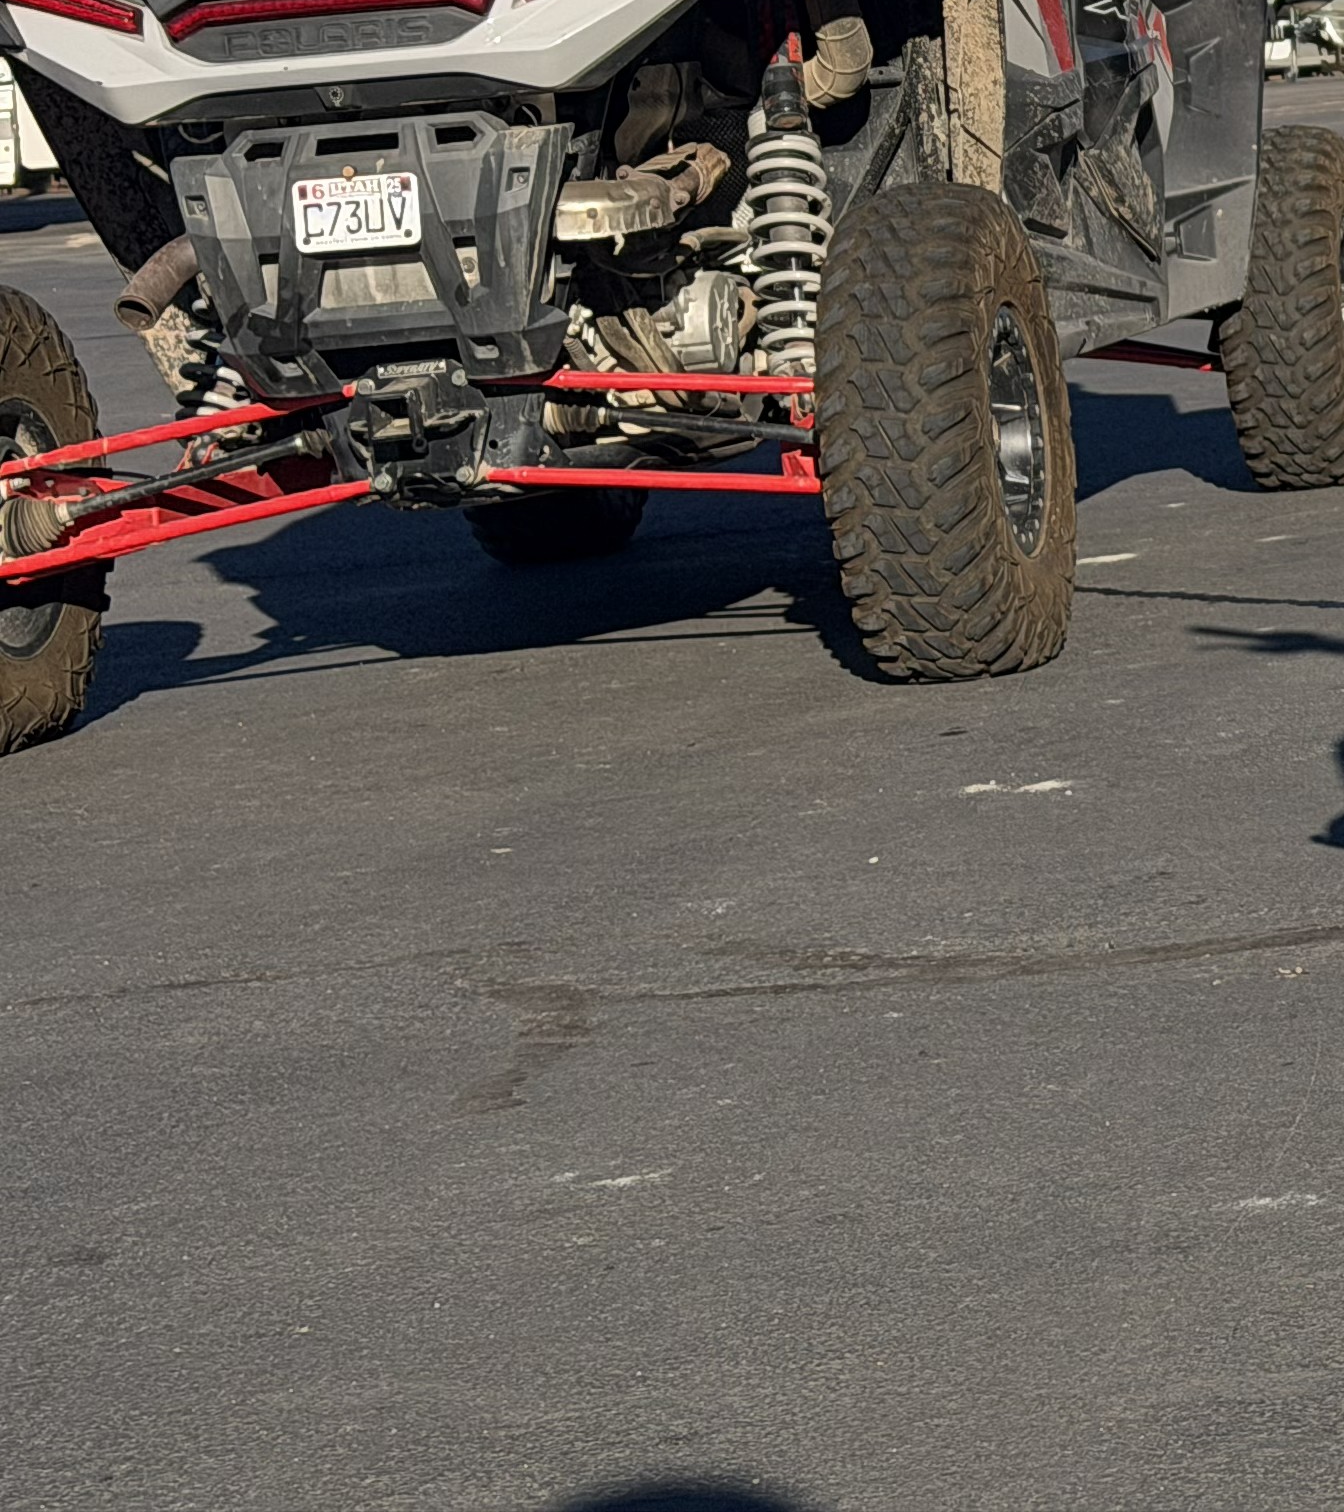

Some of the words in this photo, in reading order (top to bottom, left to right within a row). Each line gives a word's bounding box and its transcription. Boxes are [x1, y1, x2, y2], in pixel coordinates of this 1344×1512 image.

[223, 15, 433, 60] POLARIS
[311, 183, 325, 199] 6
[328, 178, 381, 197] UTAH
